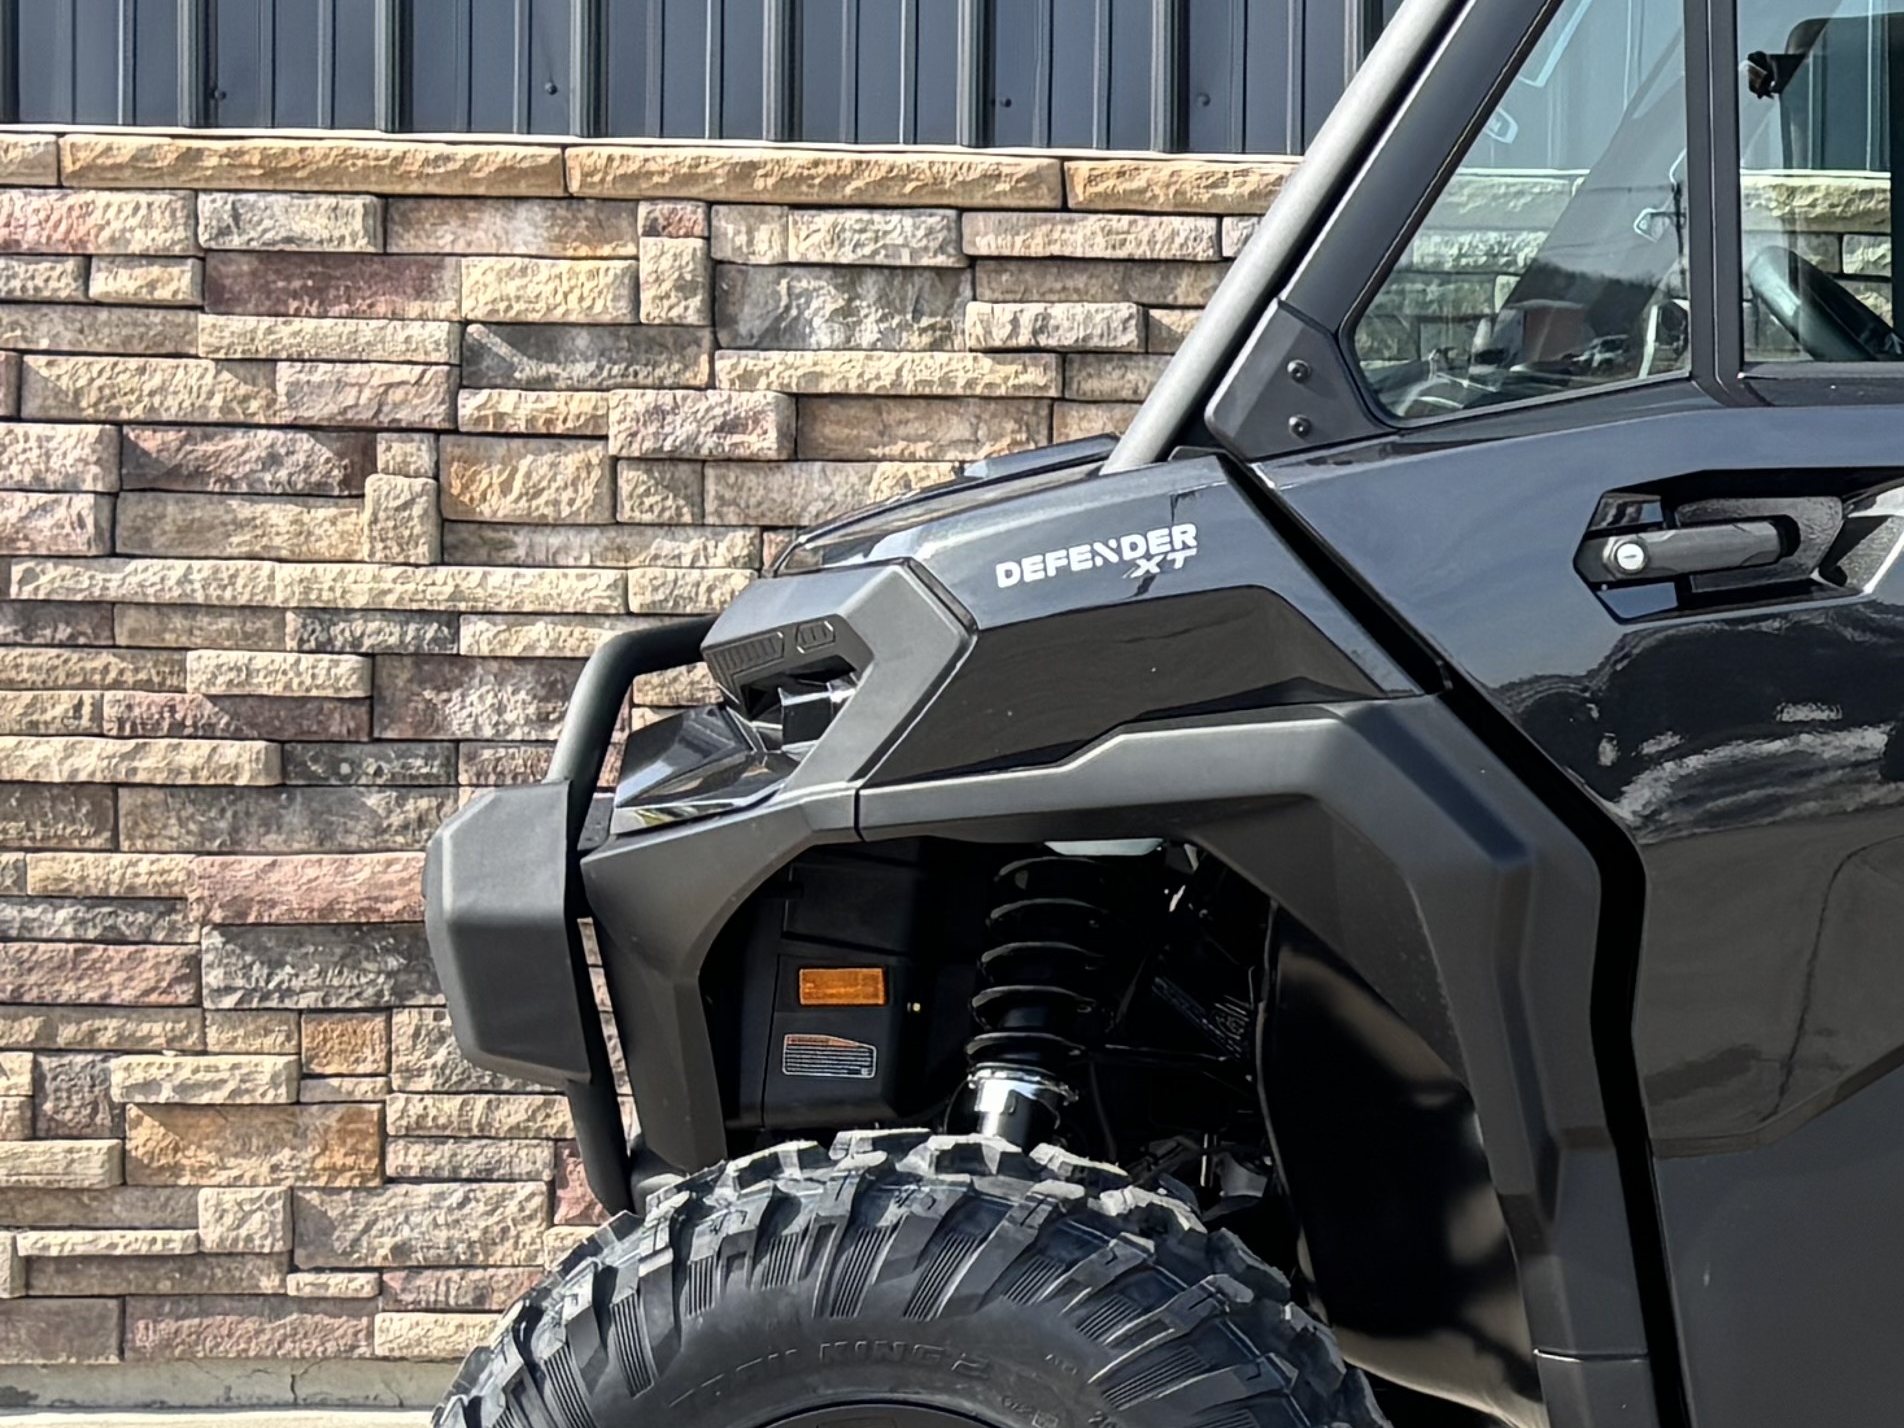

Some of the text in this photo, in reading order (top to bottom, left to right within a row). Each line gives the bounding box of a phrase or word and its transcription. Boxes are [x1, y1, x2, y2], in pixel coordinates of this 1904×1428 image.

[995, 523, 1198, 589] DEFENDER
[1122, 547, 1198, 580] XT
[818, 1339, 991, 1380] KING 2
